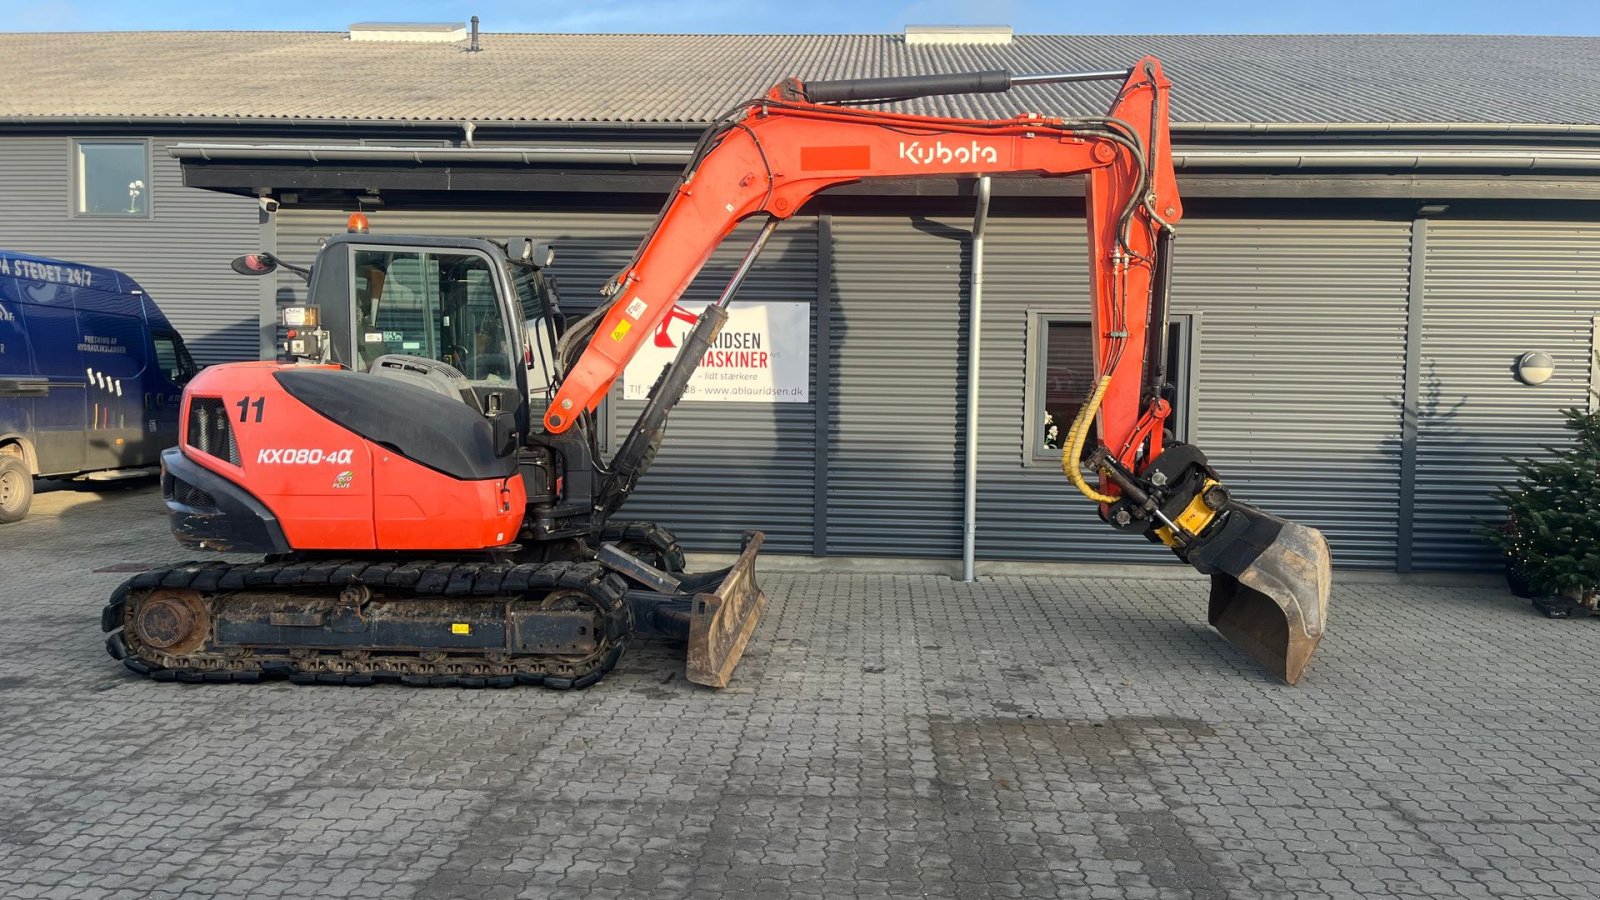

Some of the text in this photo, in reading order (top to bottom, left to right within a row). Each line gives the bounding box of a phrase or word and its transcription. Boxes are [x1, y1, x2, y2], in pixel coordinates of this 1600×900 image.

[900, 140, 997, 164] Kubota
[0, 254, 92, 287] Å STEDET 24/7
[682, 331, 761, 349] LIDSEN
[720, 372, 758, 381] stærkere
[704, 386, 803, 397] www.ablauridsen.dk
[236, 396, 266, 423] 11
